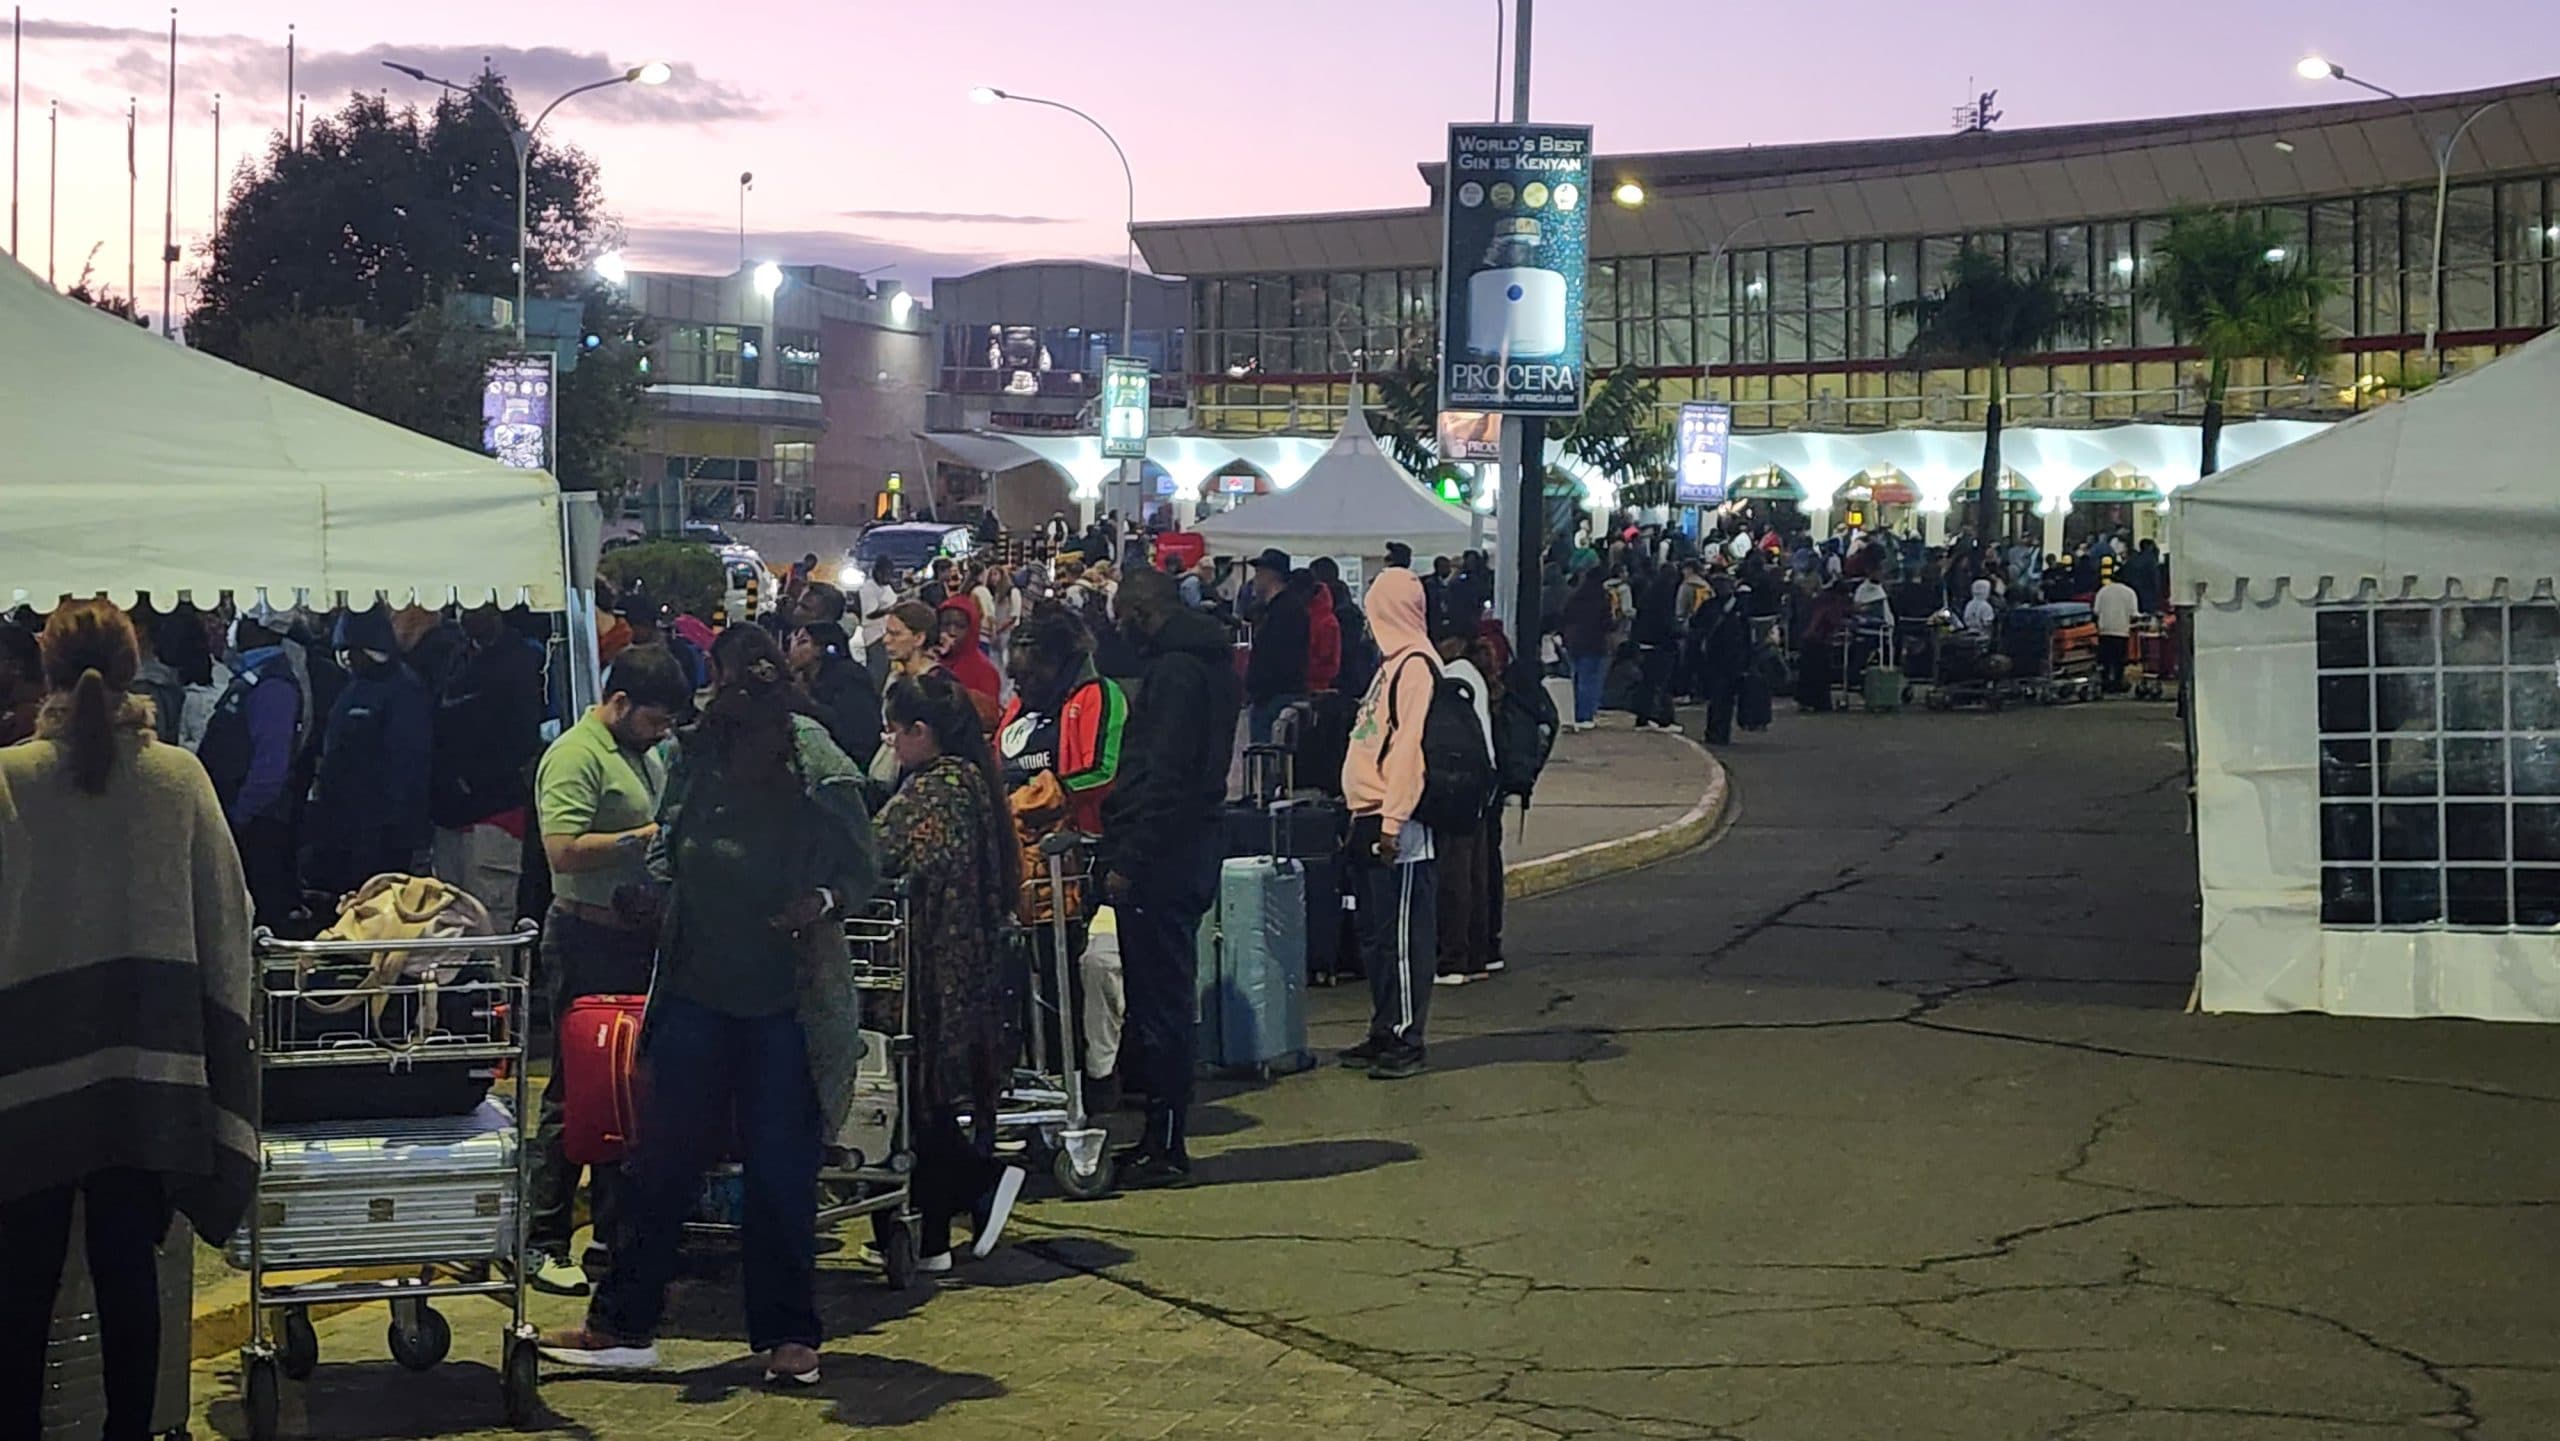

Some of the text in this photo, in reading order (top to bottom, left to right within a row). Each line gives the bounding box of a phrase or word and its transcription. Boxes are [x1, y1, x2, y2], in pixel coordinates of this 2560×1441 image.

[1457, 135, 1585, 152] WORLD'S BEST
[1459, 153, 1582, 171] GIN IS KENYAN
[1451, 364, 1575, 390] PROCERA
